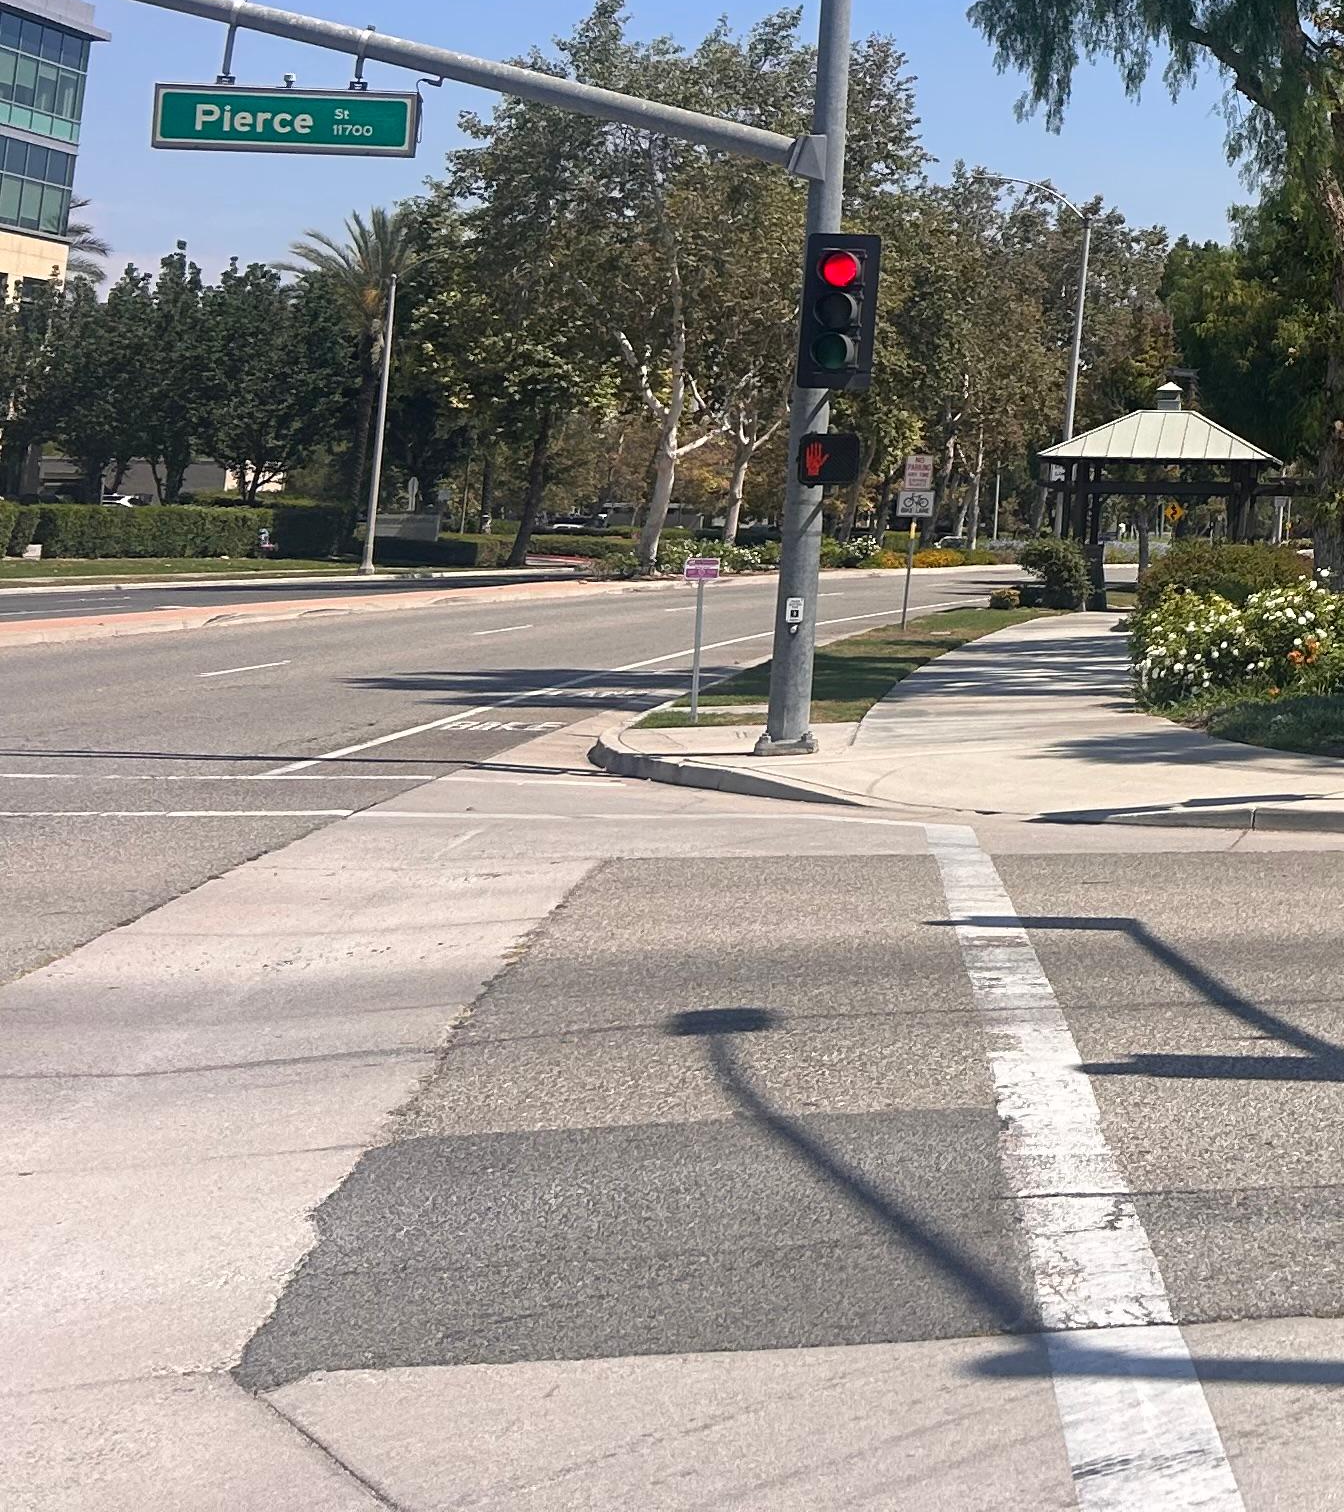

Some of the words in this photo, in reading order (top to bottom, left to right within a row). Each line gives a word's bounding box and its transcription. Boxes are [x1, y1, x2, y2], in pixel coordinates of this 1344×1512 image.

[194, 104, 315, 134] Pierce
[334, 108, 350, 120] St
[332, 124, 373, 137] 11700
[438, 721, 568, 731] BIKE
